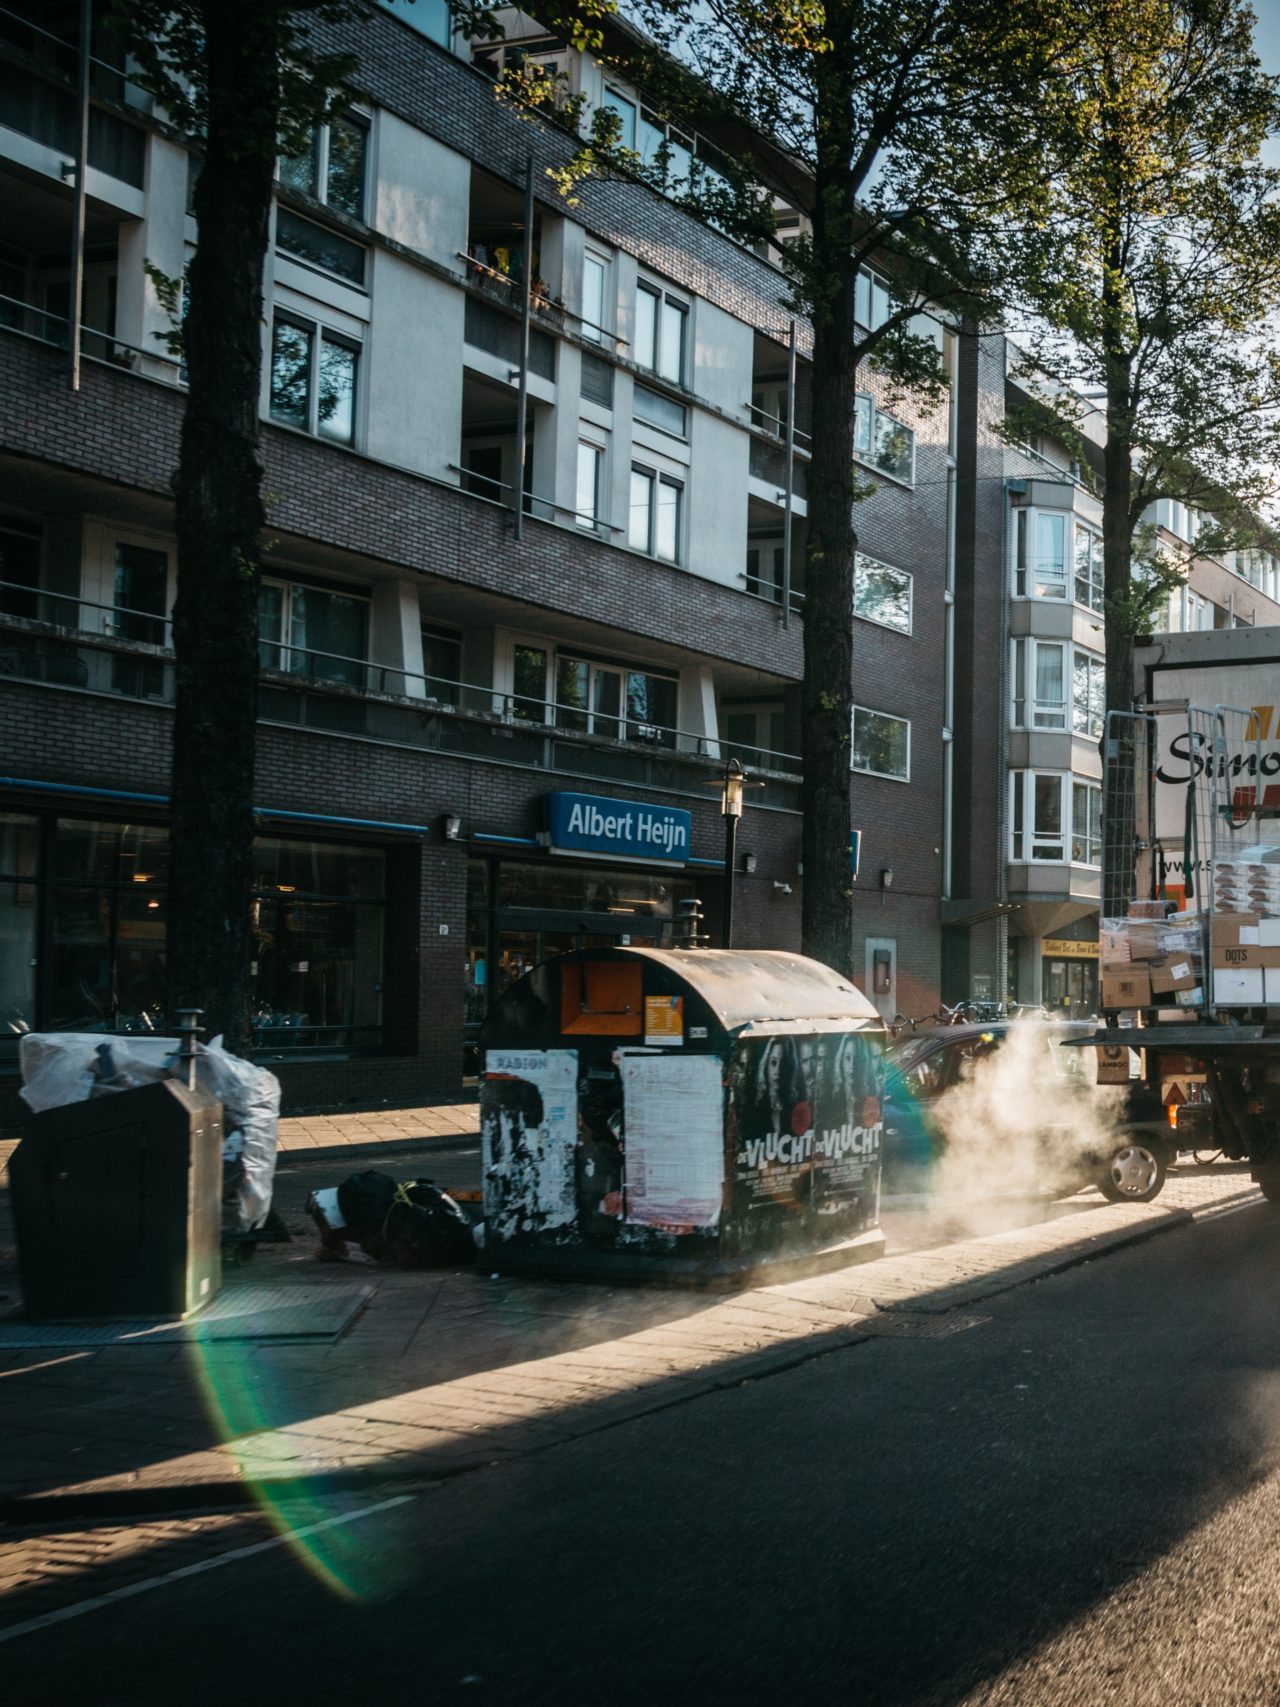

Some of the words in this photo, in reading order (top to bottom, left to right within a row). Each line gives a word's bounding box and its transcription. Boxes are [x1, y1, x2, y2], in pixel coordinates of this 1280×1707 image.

[567, 803, 633, 840] Albert
[637, 813, 685, 853] Heijn
[1225, 949, 1248, 961] DOTS
[745, 1129, 815, 1170] VLUCHT
[823, 1122, 883, 1159] VLUCHT
